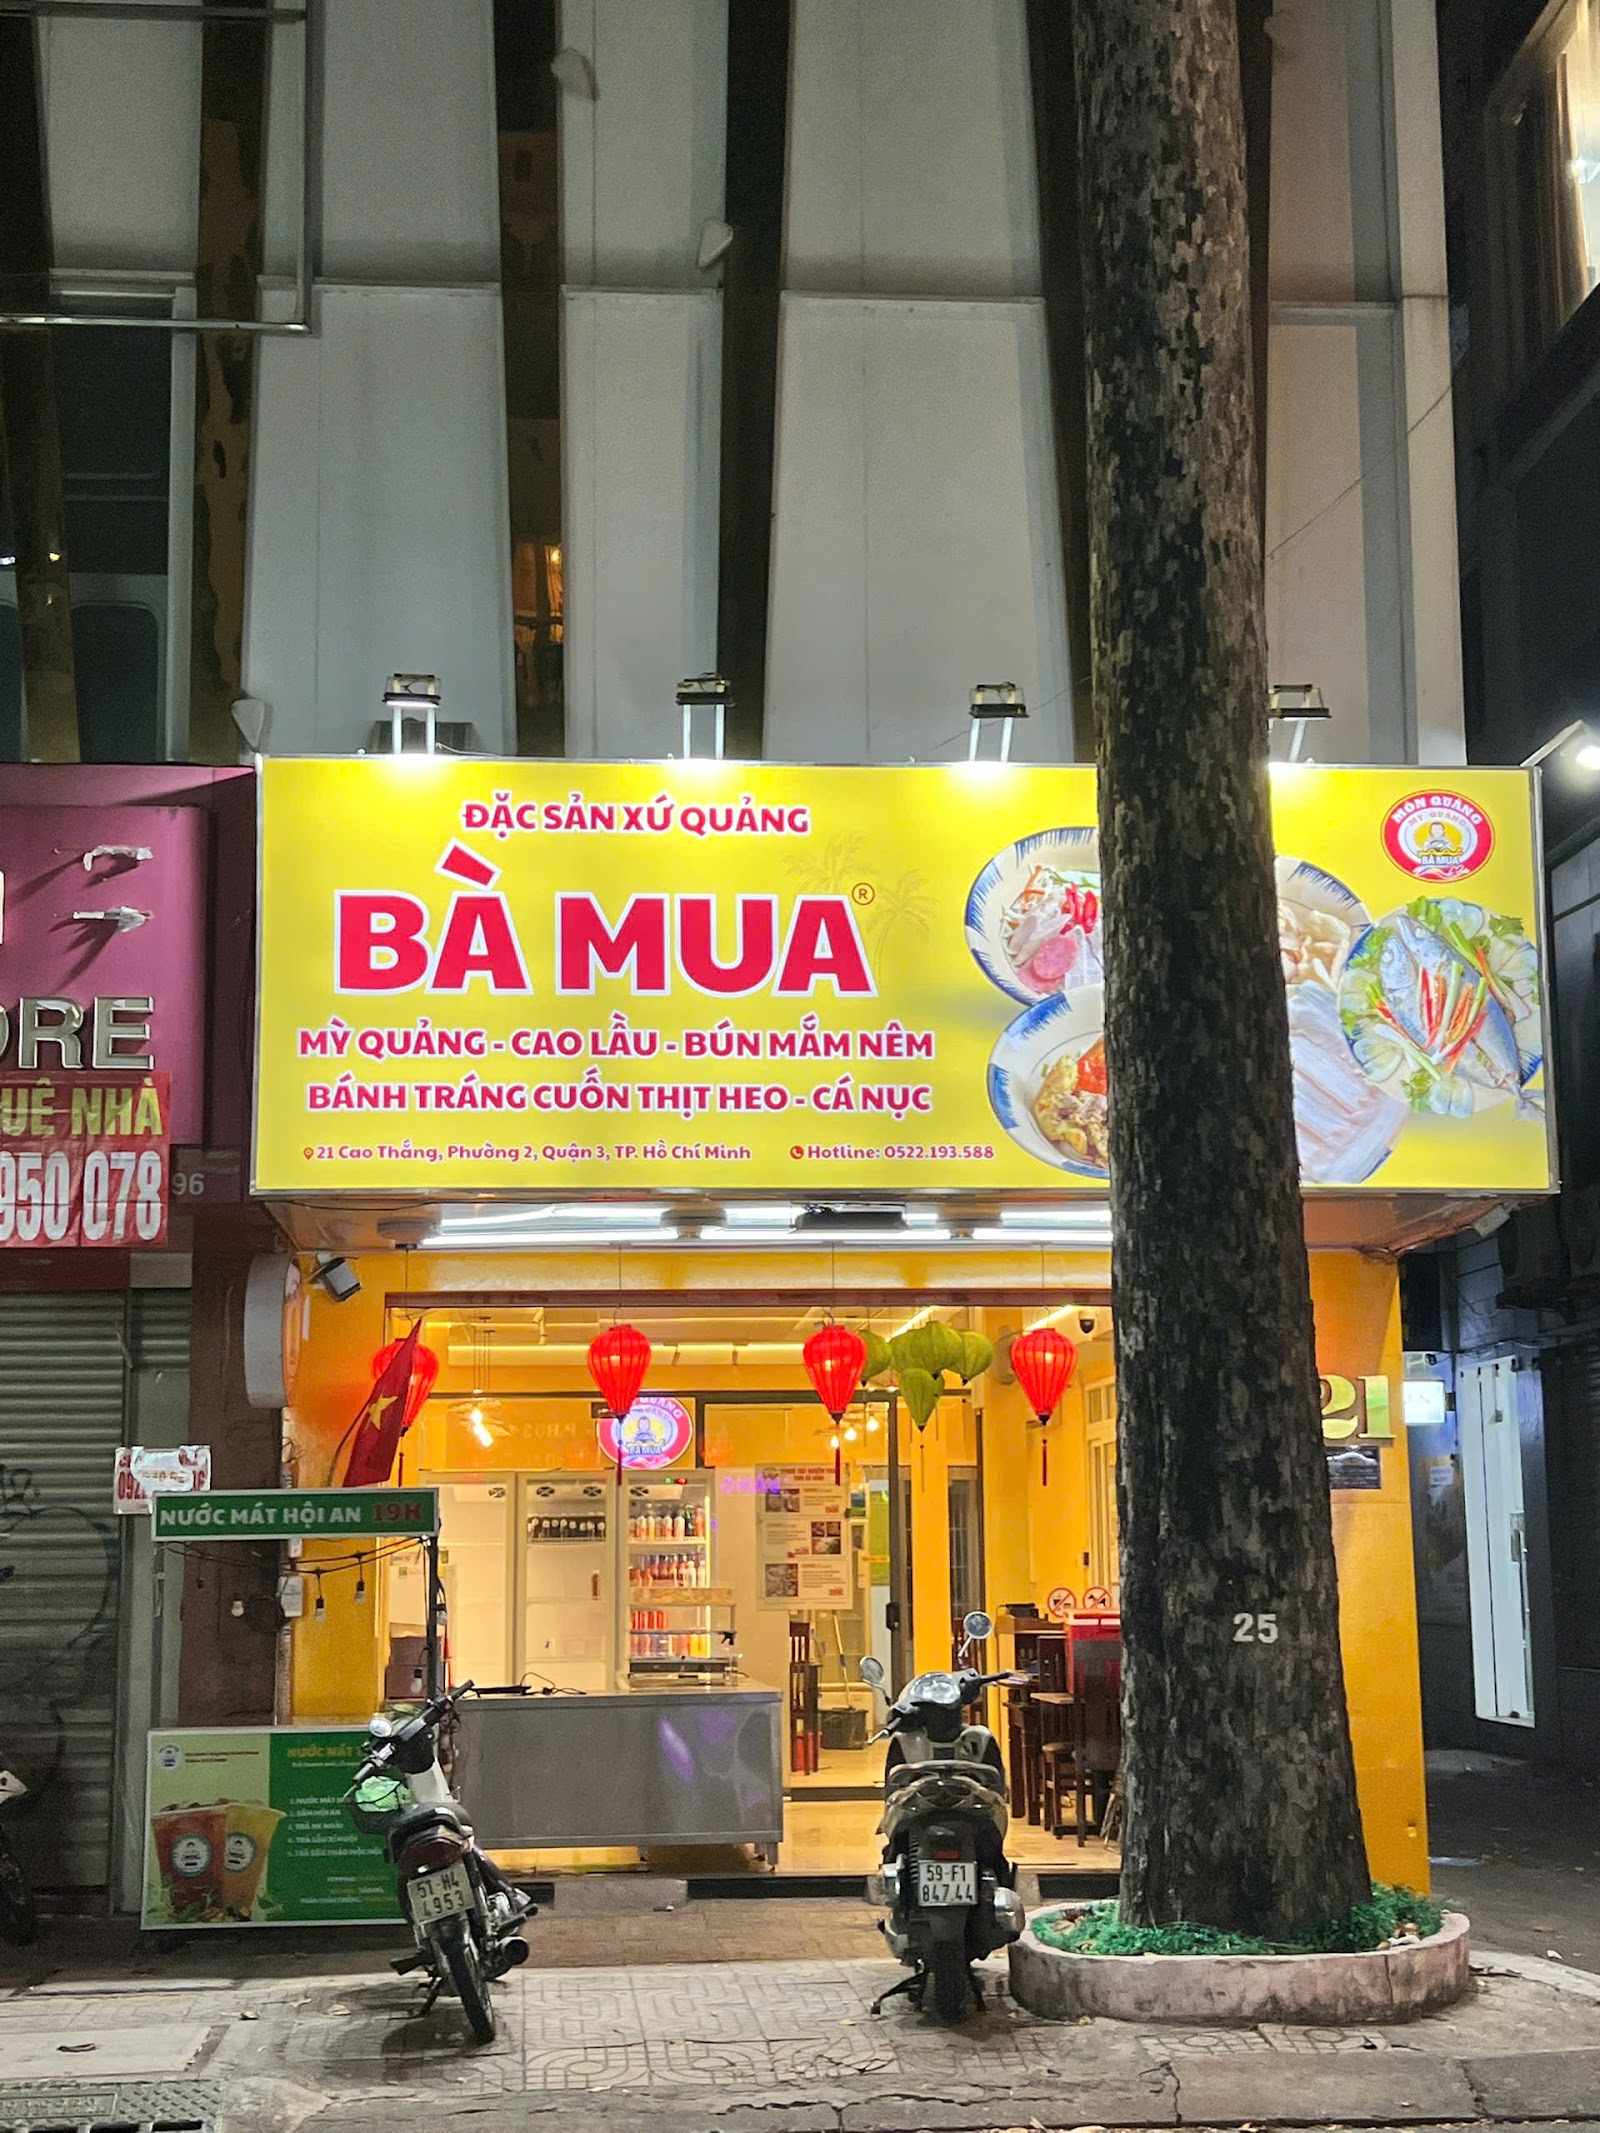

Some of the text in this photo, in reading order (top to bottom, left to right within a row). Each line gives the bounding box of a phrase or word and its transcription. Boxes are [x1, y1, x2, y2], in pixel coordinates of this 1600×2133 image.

[462, 792, 810, 838] ĐẶC SẢN XỨ QUẢNG
[337, 840, 532, 993] BÀ
[556, 892, 877, 997] MUA
[299, 1017, 351, 1056] MỲ
[358, 1019, 486, 1060] QUẢNG
[510, 1030, 583, 1056] CAO
[590, 1011, 659, 1056] LẦU
[684, 1018, 760, 1057] BÚN
[768, 1013, 851, 1058] MẮM
[858, 1021, 934, 1058] NÊM
[71, 1077, 163, 1136] NHÀ
[308, 1072, 407, 1110] BÁNH
[414, 1072, 527, 1110] TRÁNG
[533, 1066, 630, 1110] CUỐN
[637, 1085, 711, 1119] THỊT
[718, 1086, 789, 1110] HEO
[812, 1074, 855, 1111] CÁ
[861, 1086, 931, 1119] NỤC
[316, 1139, 751, 1163] 21 Cao Thắng, Phường 2, Quận 3, TP. Hồ Chí Minh
[807, 1144, 995, 1160] Hotline: 0522.193.588
[83, 1150, 162, 1241] 078
[1319, 1374, 1398, 1440] 21
[159, 1502, 226, 1526] NƯỚC
[230, 1501, 278, 1525] MÁT
[283, 1500, 325, 1529] HỘI
[328, 1506, 363, 1524] AN
[1232, 1611, 1280, 1645] 25
[922, 1884, 974, 1902] 847.44
[926, 1864, 967, 1882] 59-F1
[422, 1889, 465, 1917] 4953
